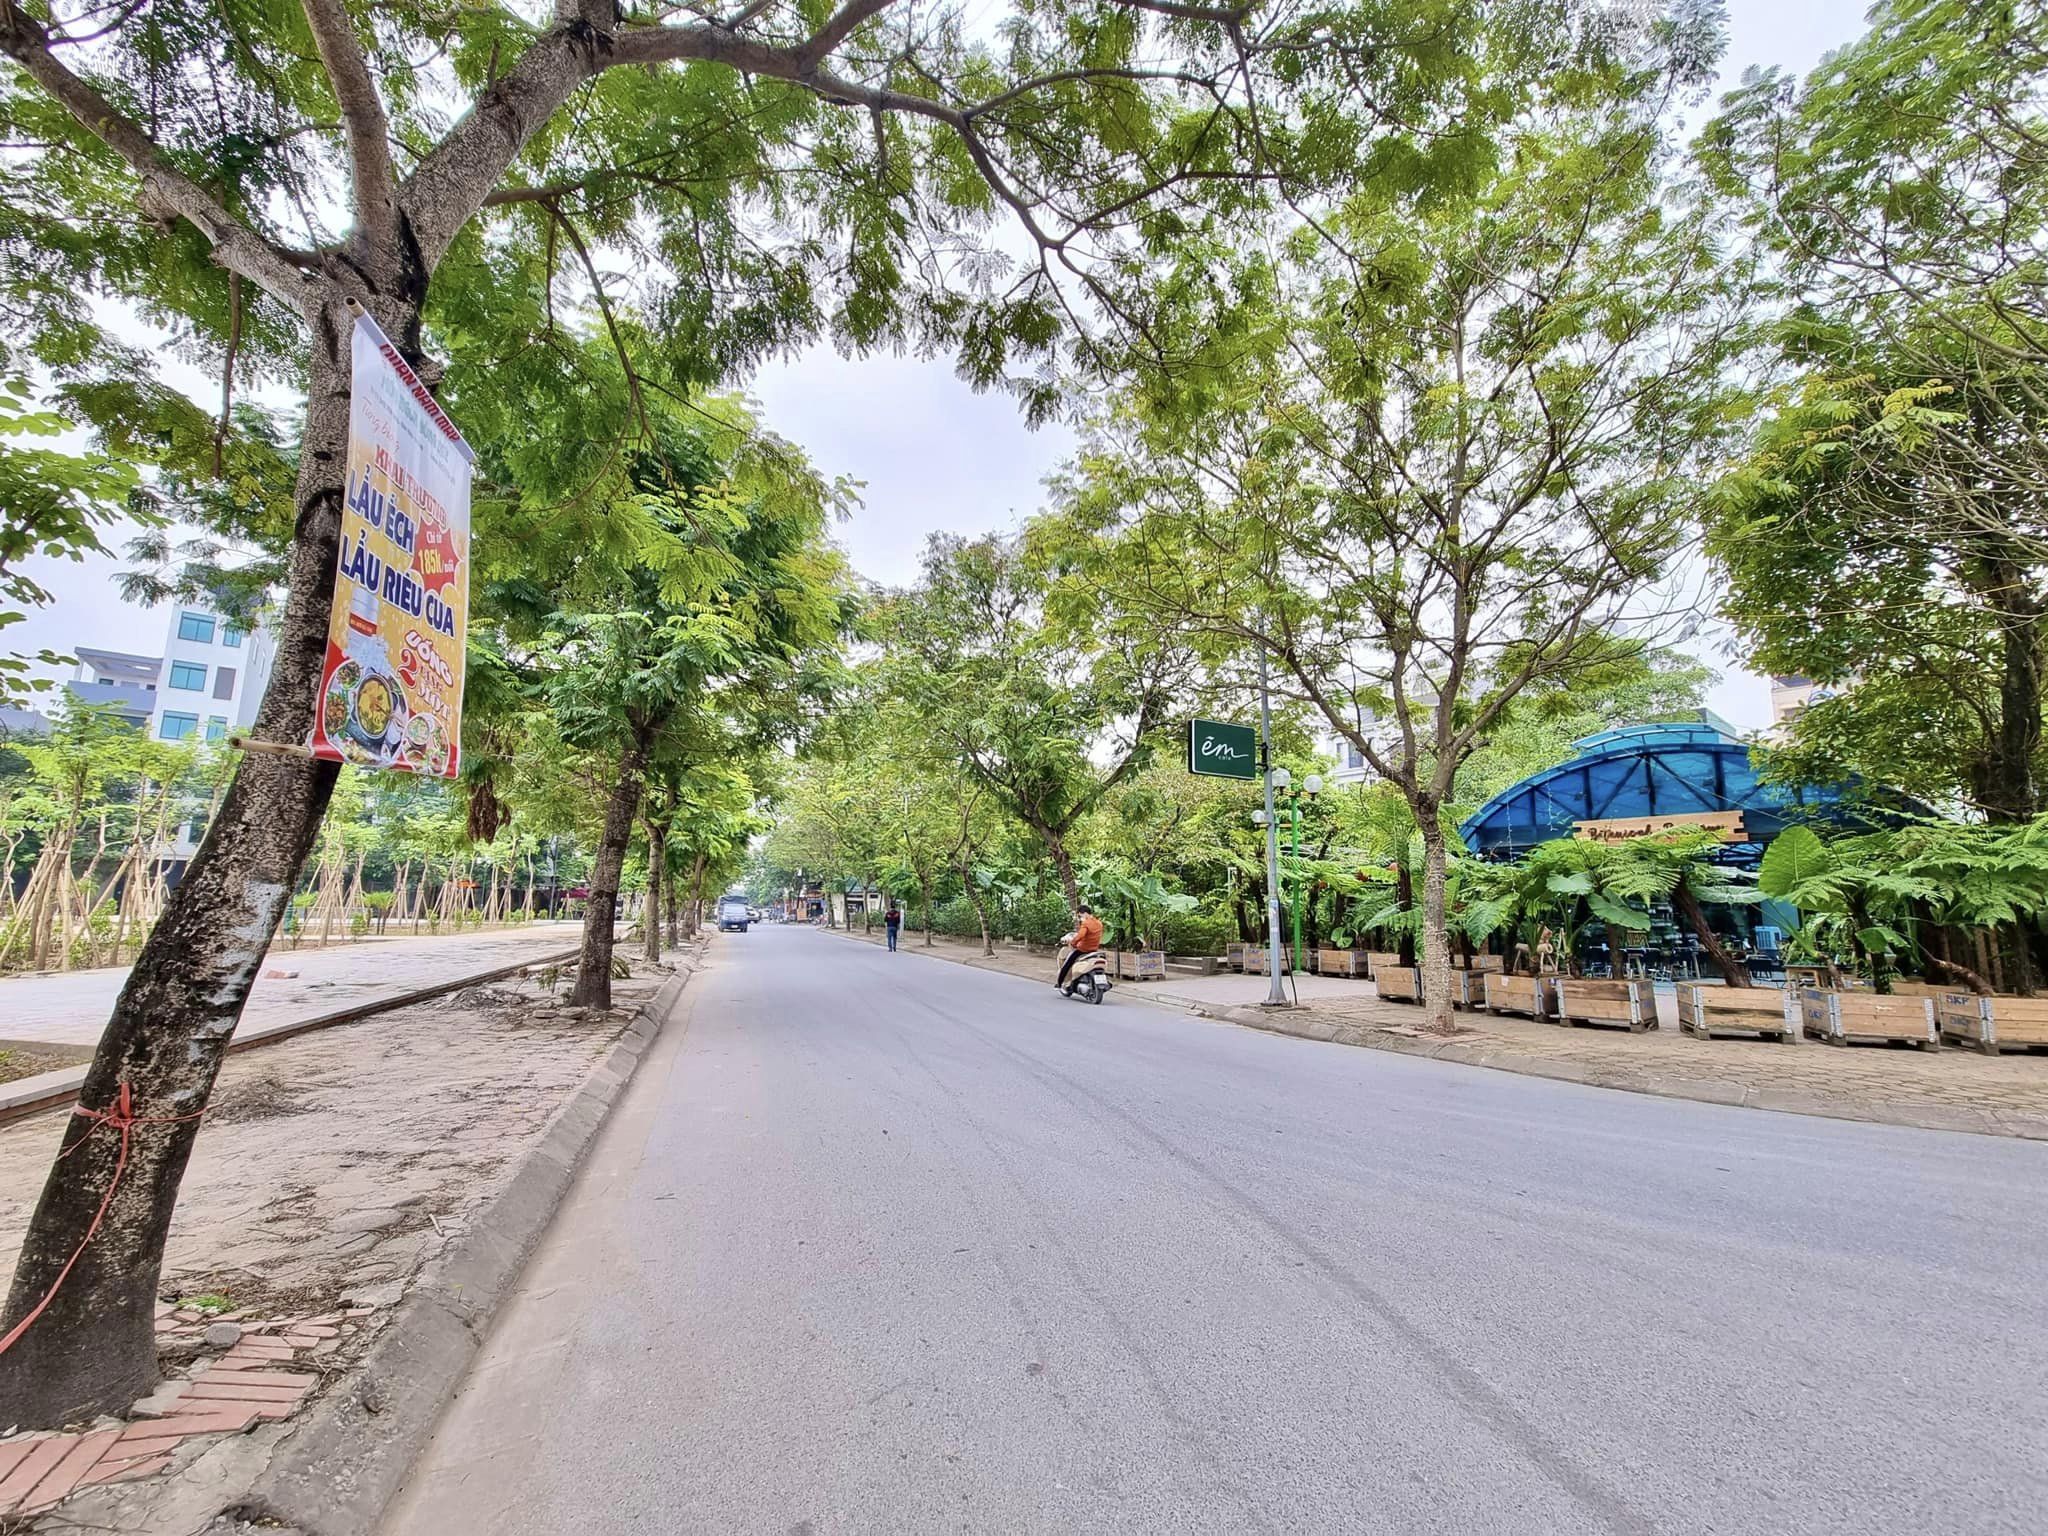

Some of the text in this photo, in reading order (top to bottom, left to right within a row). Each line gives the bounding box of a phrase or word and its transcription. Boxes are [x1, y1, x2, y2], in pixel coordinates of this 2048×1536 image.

[376, 445, 404, 487] KHAI
[348, 464, 415, 553] LẨU ẾCH
[340, 529, 454, 637] LẨU RIÊU CUA
[395, 648, 418, 689] 2
[405, 630, 453, 688] UỐNG
